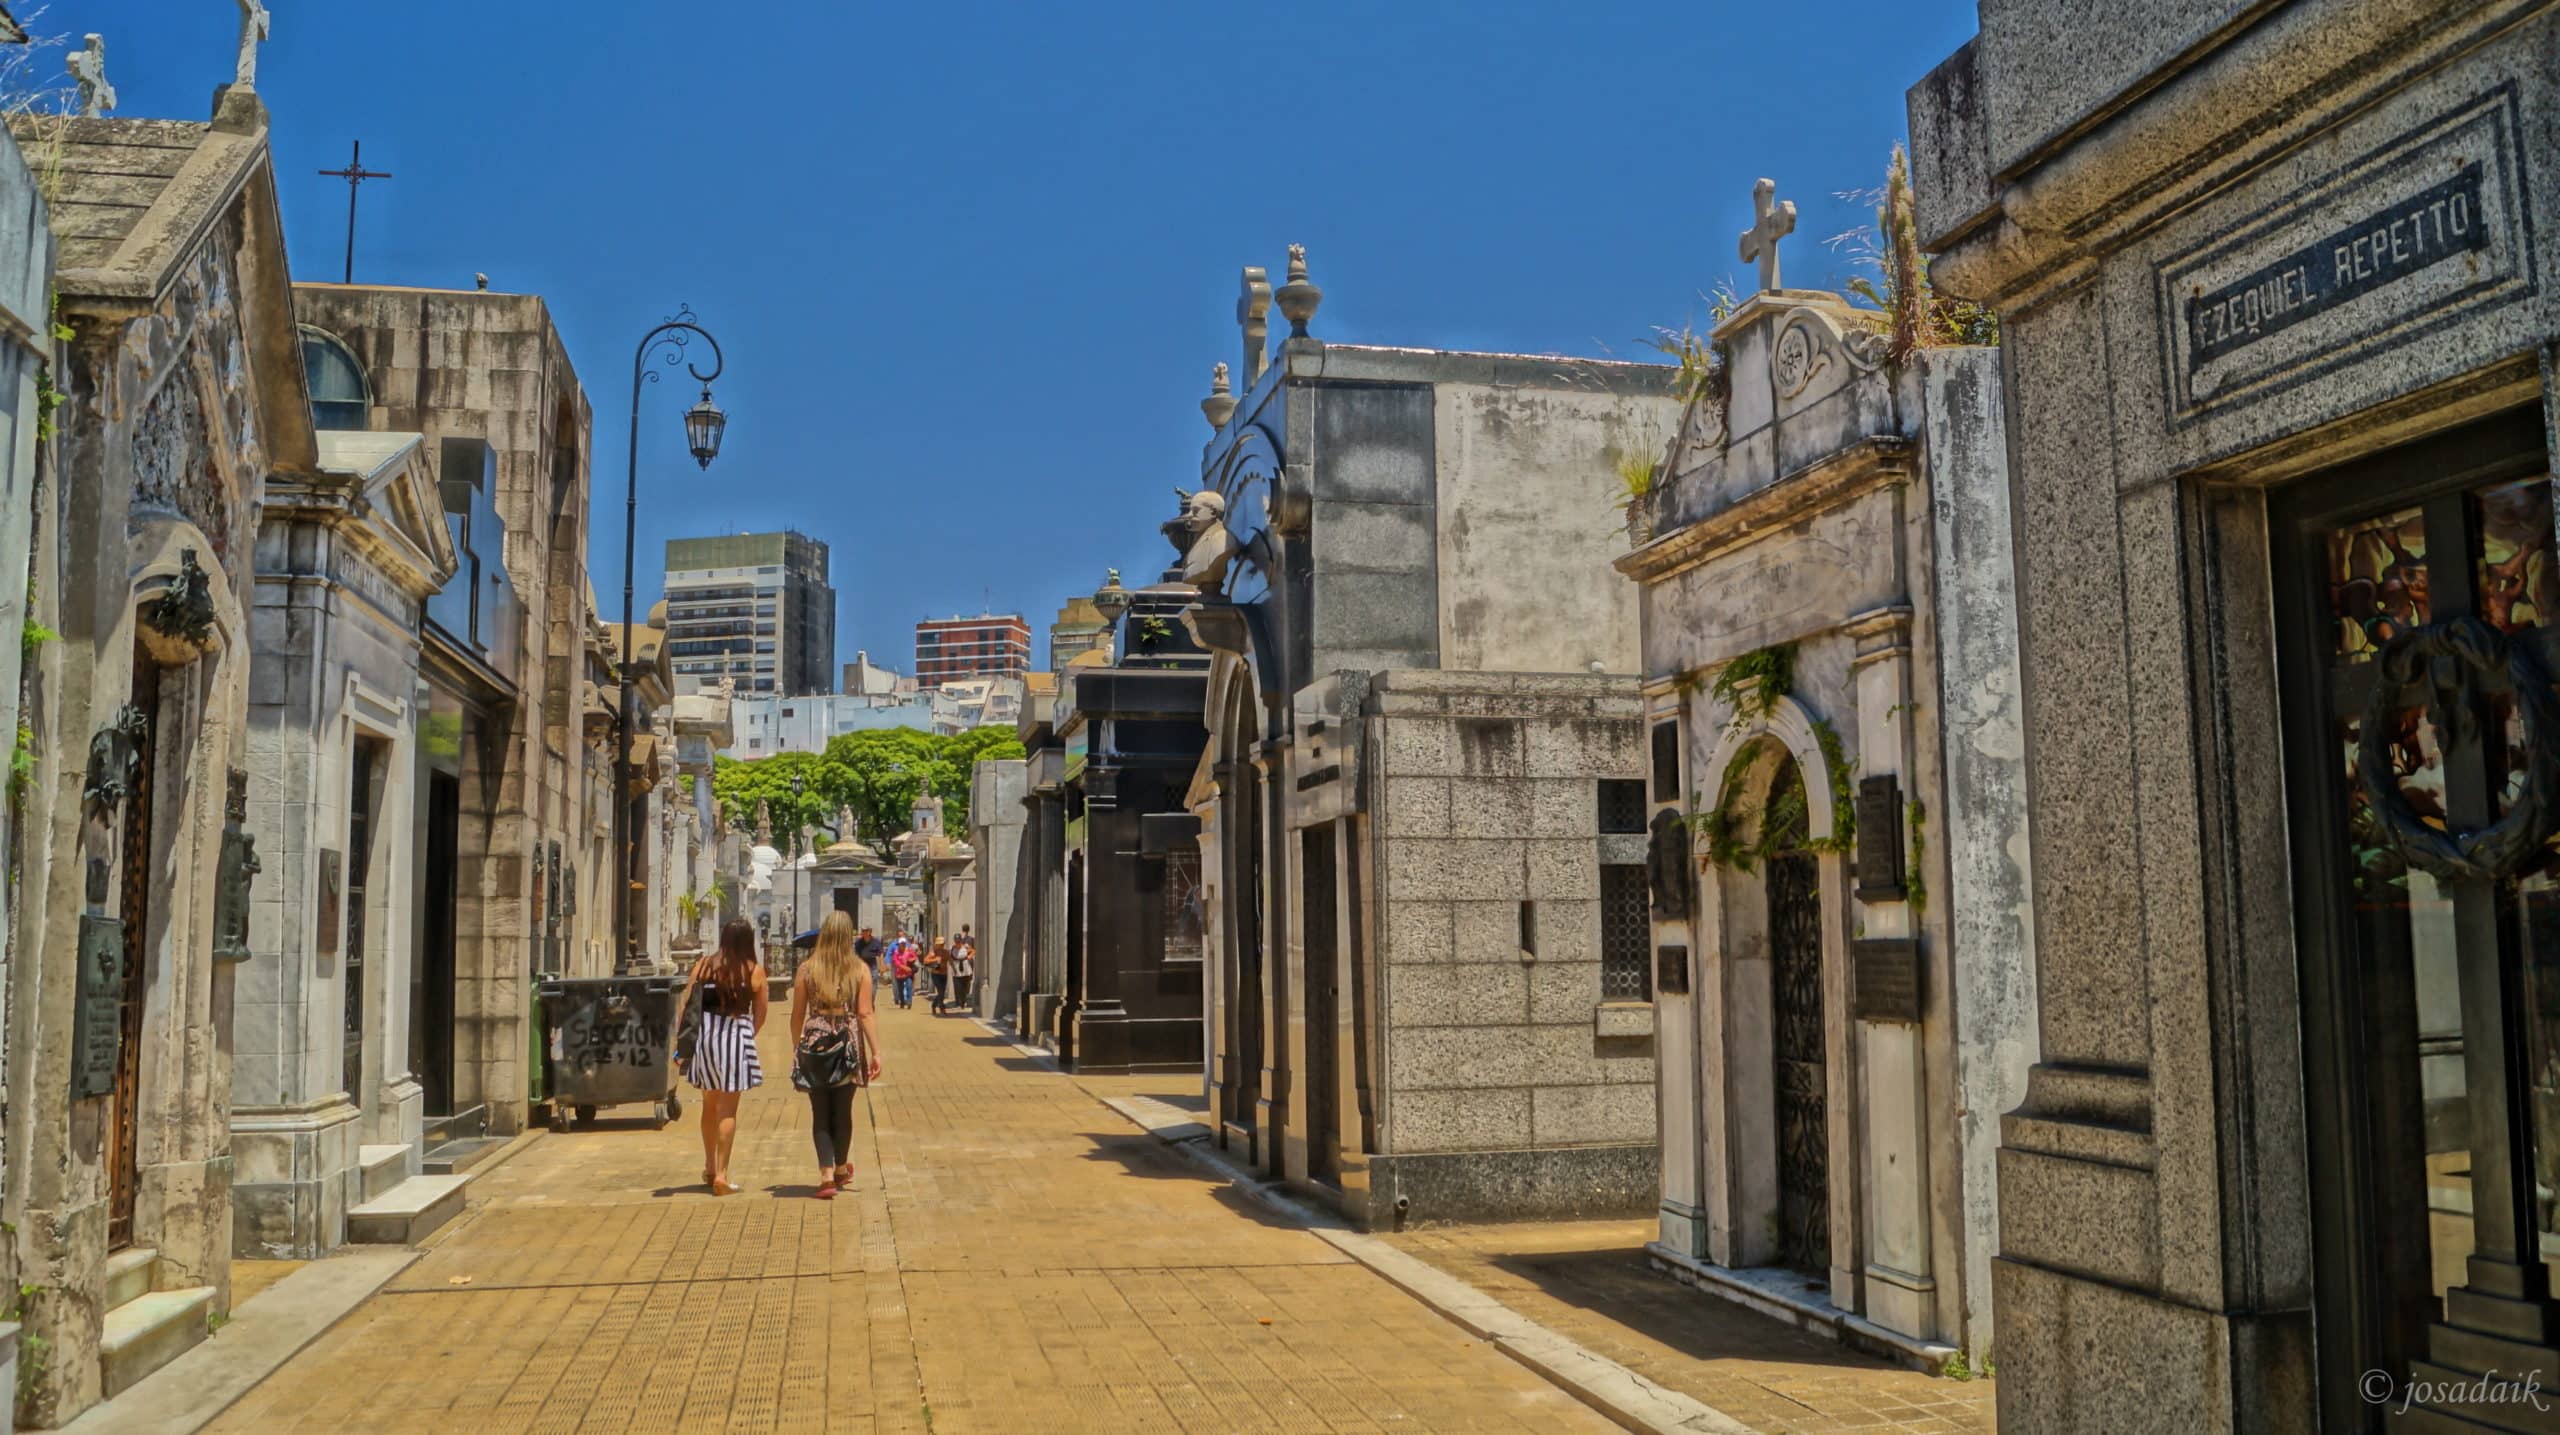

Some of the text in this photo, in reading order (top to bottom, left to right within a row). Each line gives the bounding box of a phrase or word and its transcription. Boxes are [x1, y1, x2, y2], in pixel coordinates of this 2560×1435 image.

[2196, 191, 2470, 350] EZEQUIEL REPETTO
[630, 1047, 653, 1067] 12
